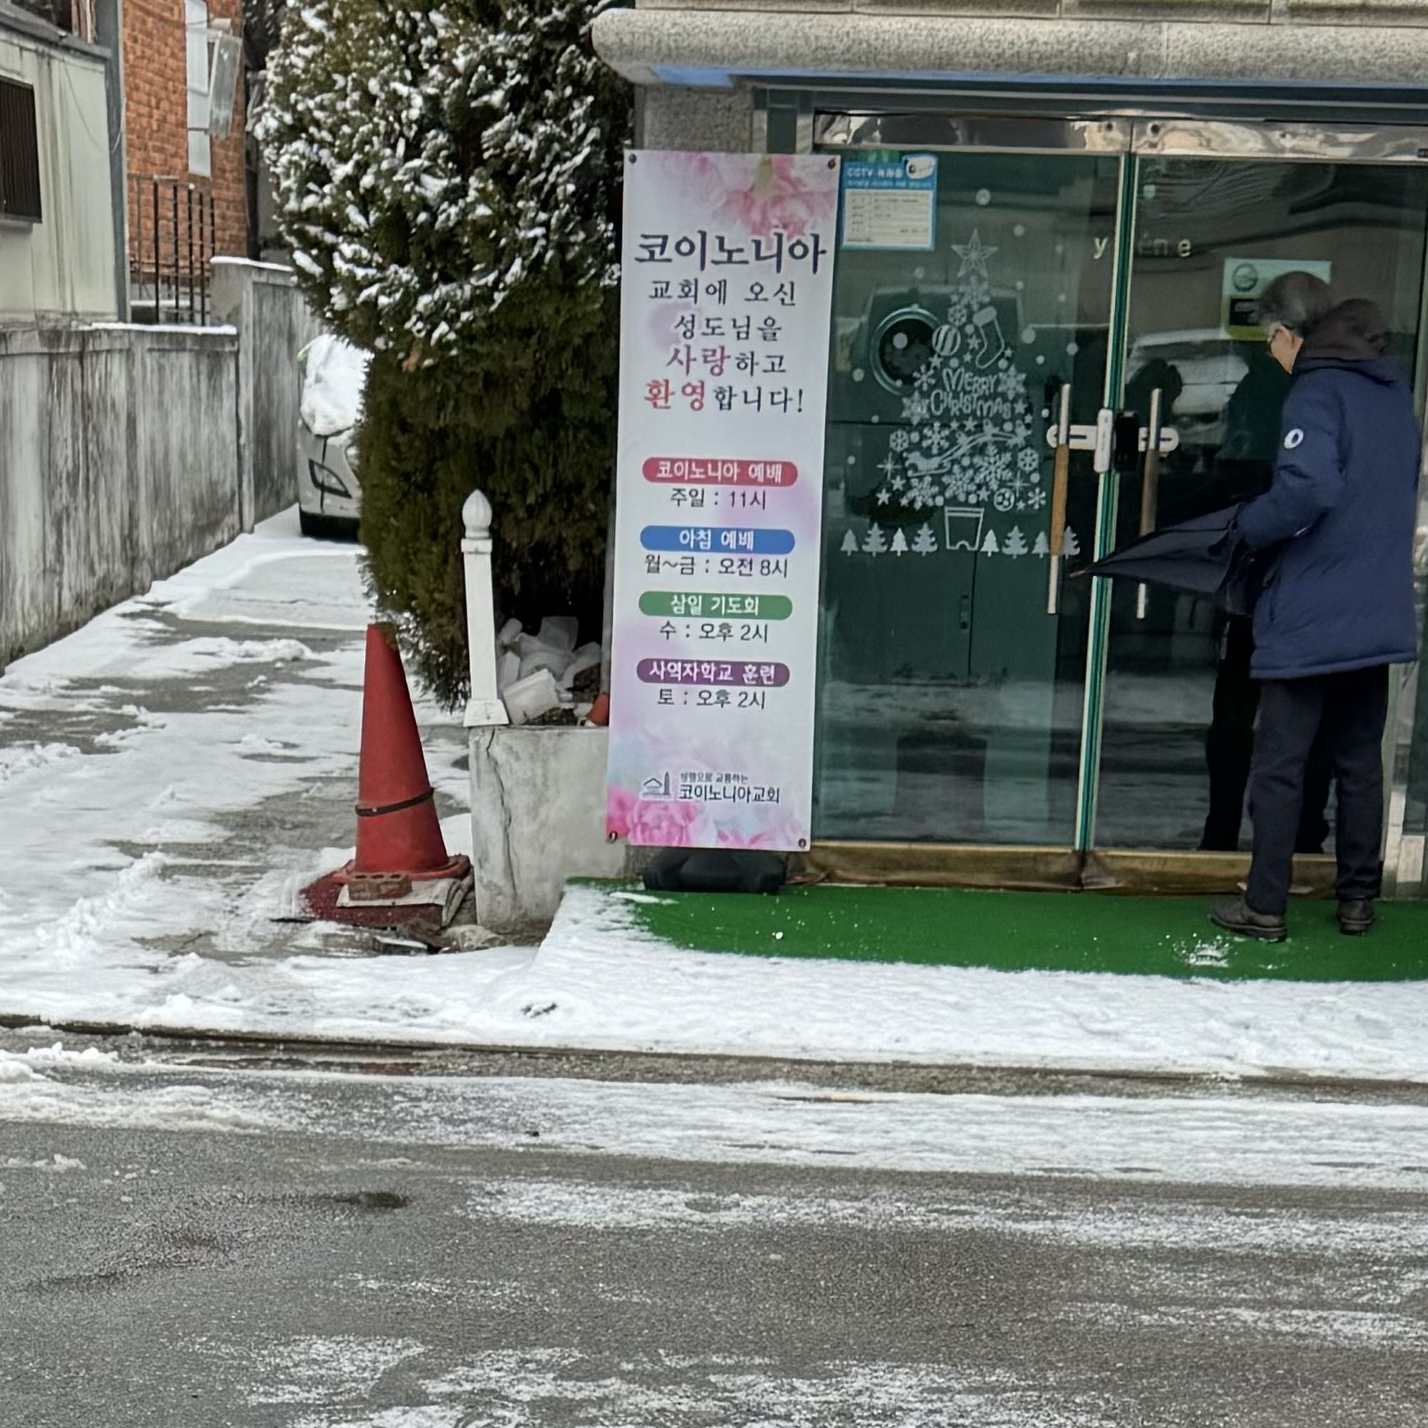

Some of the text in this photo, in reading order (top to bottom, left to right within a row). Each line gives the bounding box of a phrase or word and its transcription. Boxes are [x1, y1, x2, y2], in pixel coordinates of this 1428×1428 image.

[634, 230, 828, 274] 코이노니아
[649, 278, 796, 307] 교회에 오신
[674, 313, 782, 342] 성도님을
[666, 344, 786, 377] 사랑하고
[644, 379, 804, 413] 환영합니다!
[656, 461, 783, 484] 코이노니아 예배
[670, 488, 705, 507] 주일
[730, 490, 766, 510] 11시
[679, 528, 754, 551] 아침 예배
[718, 558, 753, 577] 오전
[760, 558, 788, 579] 8시
[670, 594, 760, 616] 삼일 기도회
[659, 620, 677, 641] 수
[698, 622, 734, 642] 오후
[740, 623, 768, 643] 2시
[649, 661, 775, 685] 사역자학교 훈련
[657, 689, 675, 706] 토
[696, 689, 732, 709] 오후
[738, 690, 766, 710] 2시
[679, 784, 780, 804] 코이노니아교회
